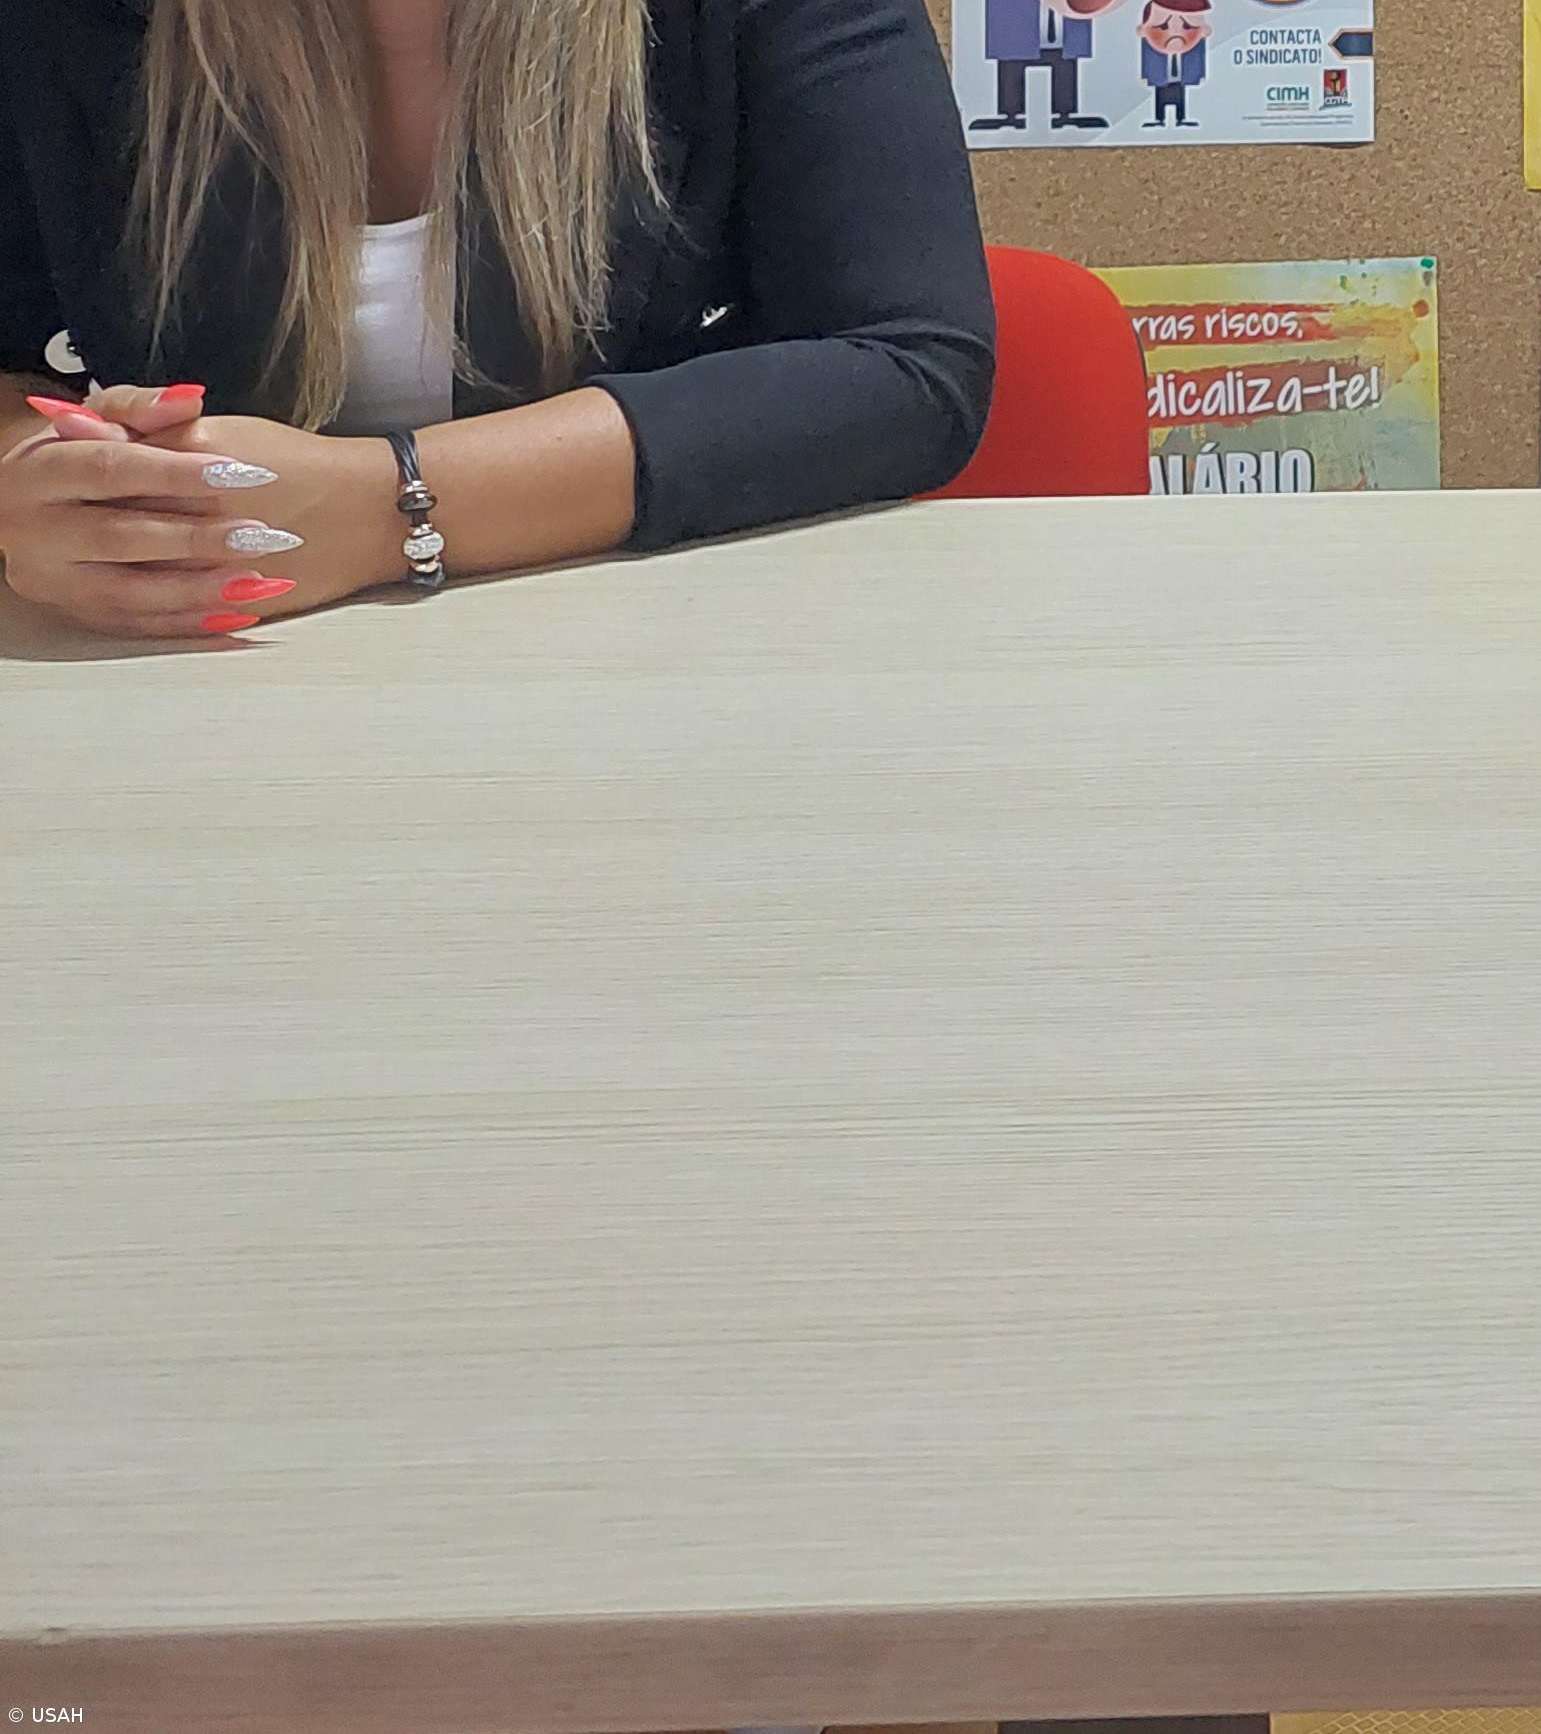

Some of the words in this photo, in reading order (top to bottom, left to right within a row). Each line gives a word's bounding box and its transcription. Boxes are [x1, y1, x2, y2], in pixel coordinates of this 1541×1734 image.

[1250, 30, 1321, 46] CONTACTA
[1234, 49, 1243, 65] O
[1246, 49, 1322, 65] SINDICATO!
[1267, 86, 1309, 101] CIMH
[1132, 315, 1195, 340] rras
[1147, 366, 1380, 418] dicaliza-te!
